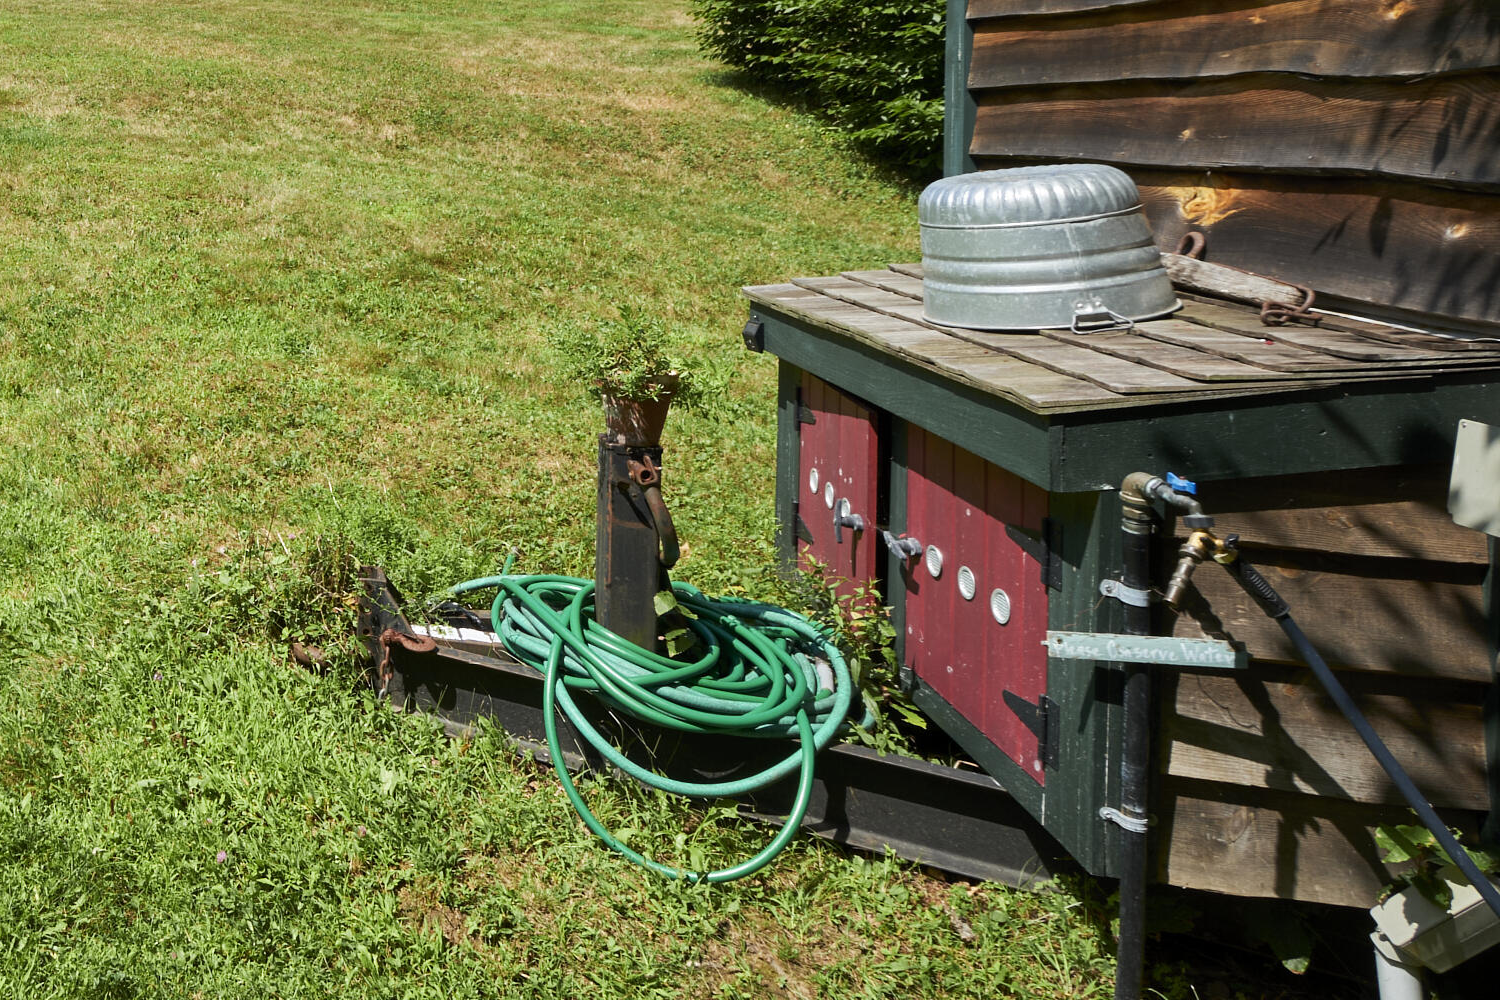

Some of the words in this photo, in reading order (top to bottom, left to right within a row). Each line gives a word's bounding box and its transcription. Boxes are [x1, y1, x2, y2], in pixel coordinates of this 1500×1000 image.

[1052, 640, 1102, 657] Please
[1107, 640, 1178, 661] Conserve
[1180, 643, 1235, 664] Water
